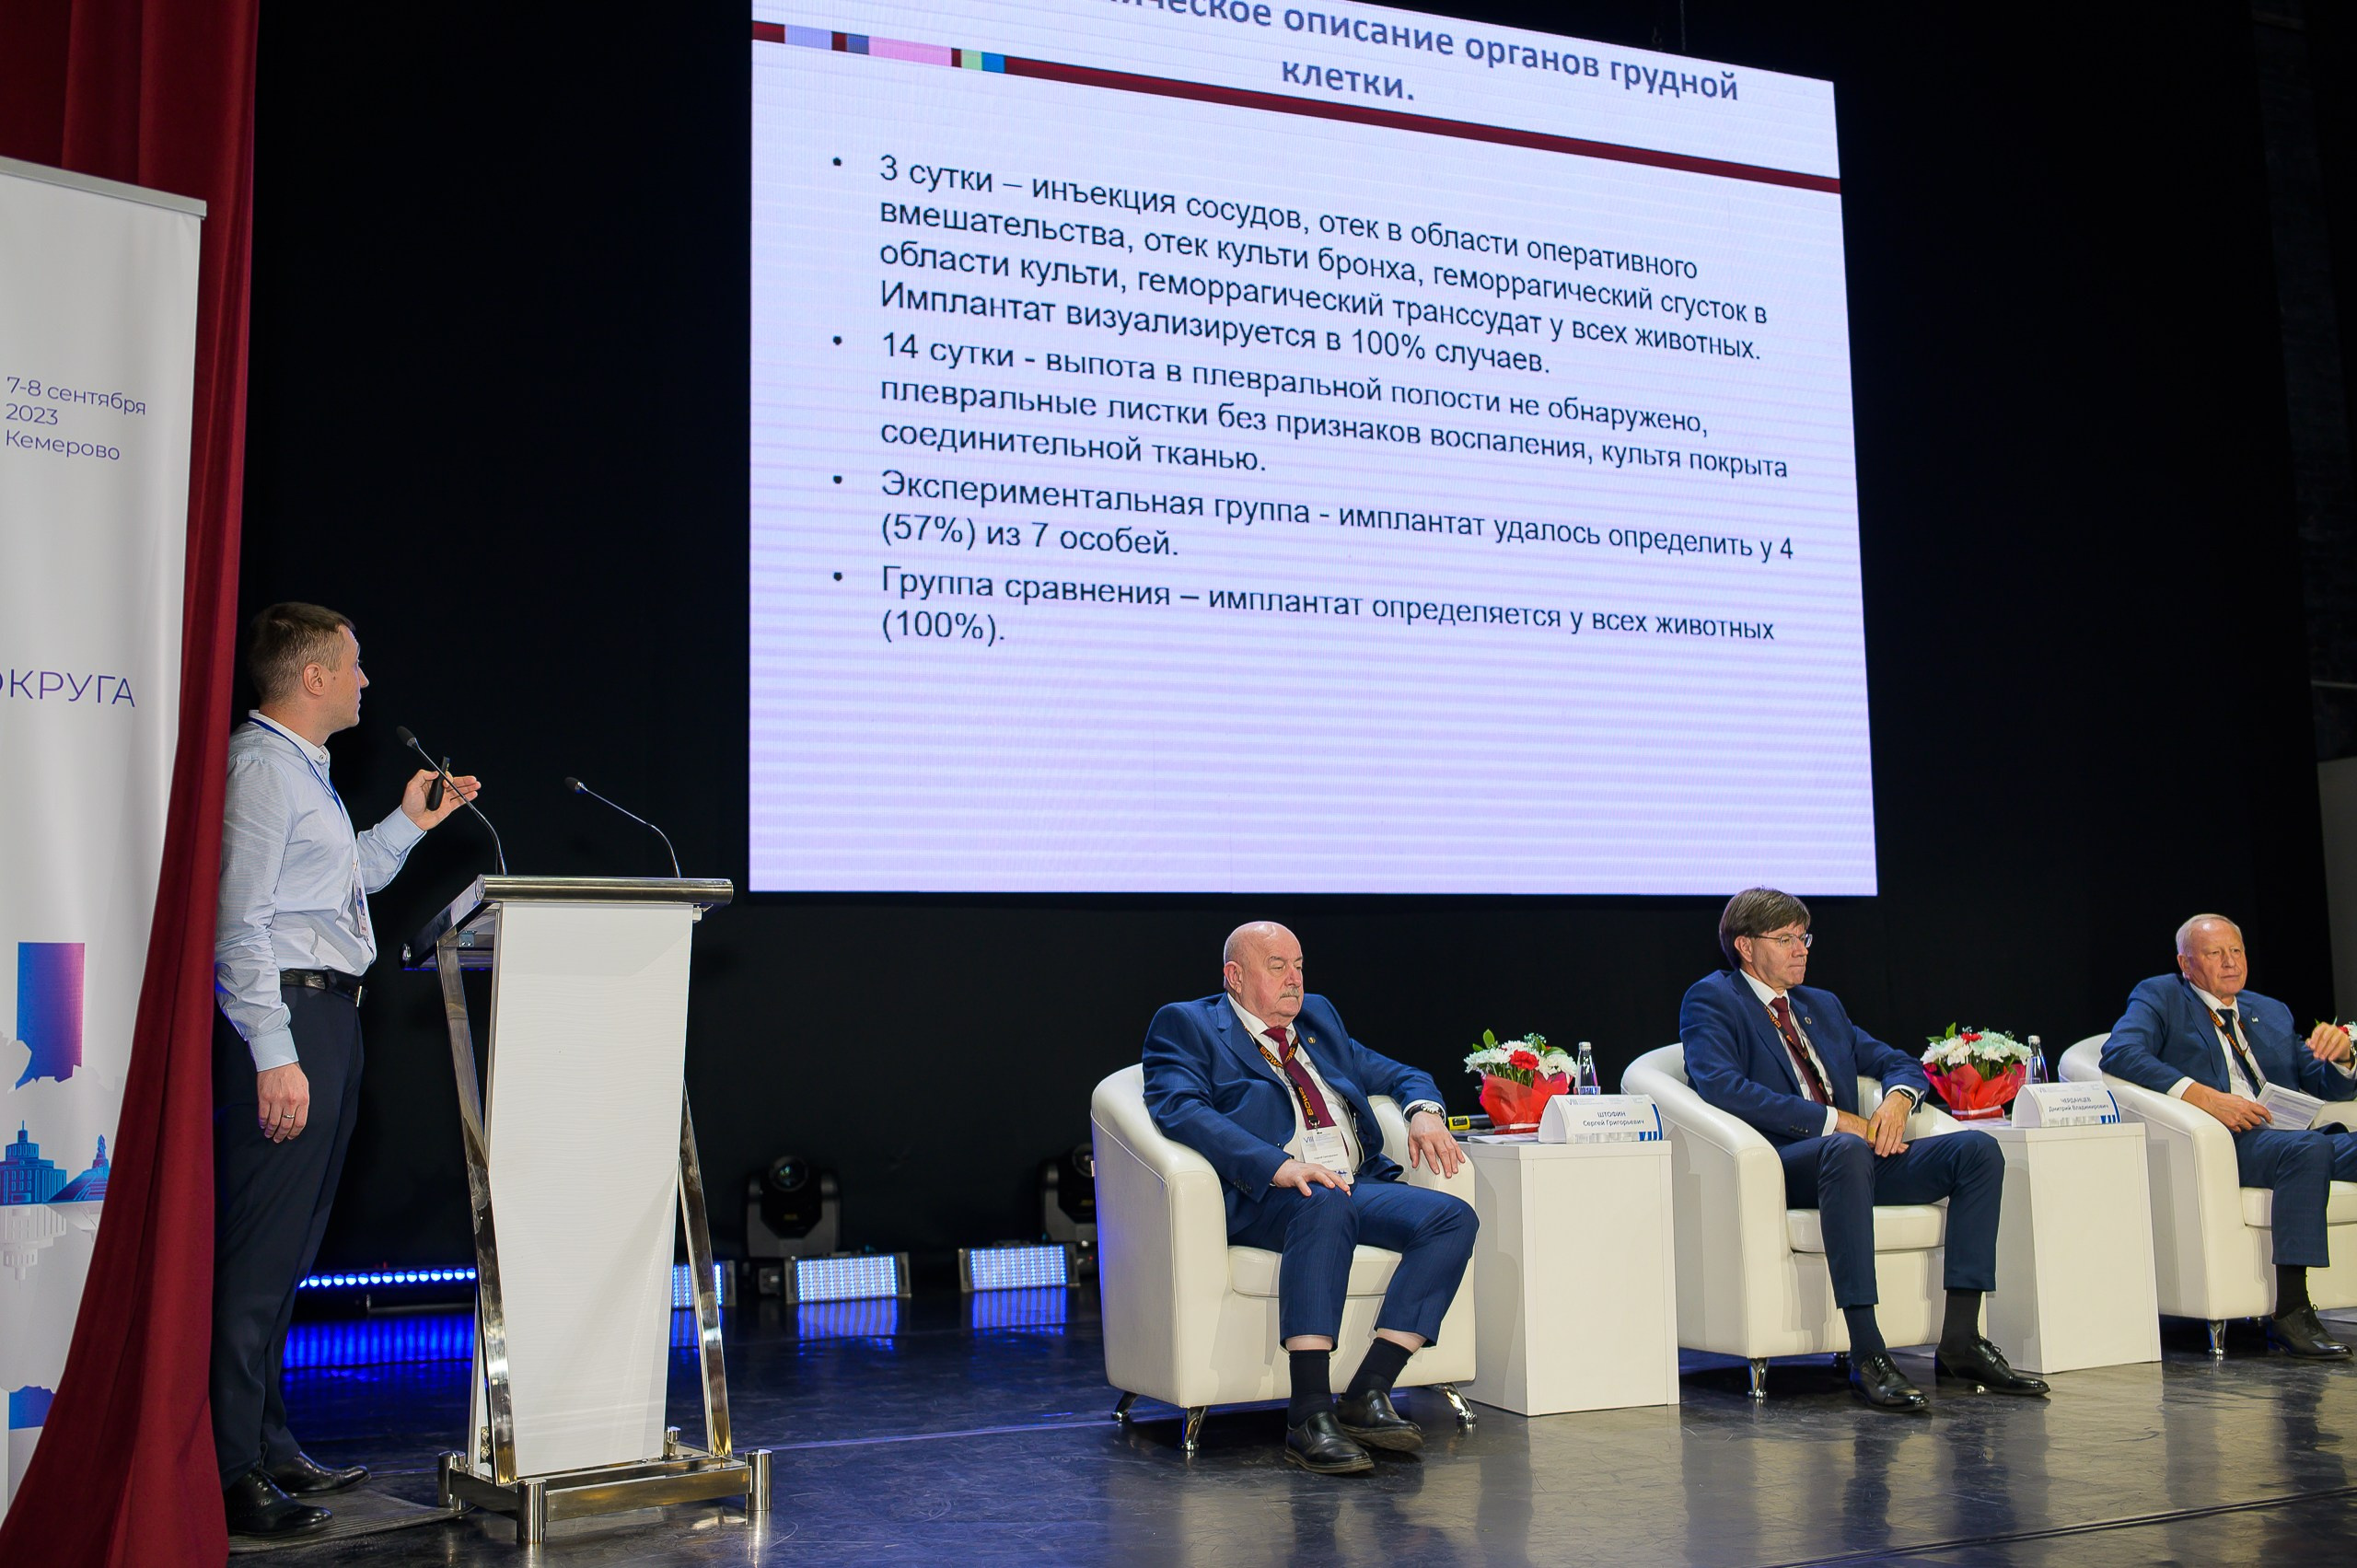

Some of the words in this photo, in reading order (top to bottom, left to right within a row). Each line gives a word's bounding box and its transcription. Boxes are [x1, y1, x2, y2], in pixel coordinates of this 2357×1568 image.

[1283, 8, 1454, 56] описание
[1465, 37, 1599, 77] органов
[1609, 61, 1737, 100] грудной
[1282, 61, 1415, 100] клетки.
[879, 154, 898, 181] 3
[909, 163, 993, 193] сутки
[1032, 178, 1176, 215] инъекция
[1186, 197, 1309, 235] сосудов,
[1318, 214, 1379, 239] отек
[1387, 222, 1403, 242] в
[1411, 221, 1518, 257] области
[1527, 239, 1698, 279] оперативного
[880, 202, 1133, 254] вмешательства,
[1144, 232, 1209, 258] отек
[1217, 239, 1308, 270] культи
[1318, 246, 1423, 287] бронха,
[1434, 266, 1653, 310] геморрагический
[1660, 294, 1748, 322] сгусток
[1754, 306, 1768, 324] в
[879, 239, 1009, 277] области
[1020, 258, 1126, 295] культи,
[1138, 271, 1383, 317] геморрагический
[1391, 299, 1542, 337] транссудат
[1550, 317, 1564, 343] у
[1572, 319, 1628, 344] всех
[1634, 327, 1760, 360] животных.
[881, 279, 1057, 322] Имплантат
[1066, 304, 1316, 349] визуализируется
[1326, 331, 1341, 352] в
[1352, 328, 1426, 360] 100%
[1435, 343, 1550, 374] случаев.
[6, 377, 41, 397] 7-8
[47, 384, 146, 415] сентября
[883, 331, 919, 359] 14
[929, 342, 1014, 370] сутки
[1046, 353, 1155, 380] выпота
[1167, 364, 1182, 382] в
[1192, 366, 1382, 401] плевральной
[1391, 386, 1501, 412] полости
[1509, 397, 1540, 416] не
[1548, 396, 1708, 438] обнаружено,
[6, 403, 58, 425] 2023
[881, 380, 1097, 416] плевральные
[1106, 399, 1208, 425] листки
[1217, 401, 1267, 431] без
[1276, 413, 1422, 444] признаков
[1430, 428, 1593, 465] воспаления,
[1601, 444, 1681, 469] культя
[1689, 452, 1788, 479] покрыта
[6, 429, 120, 460] Кемерово
[881, 424, 1142, 462] соединительной
[1151, 444, 1266, 471] тканью.
[881, 513, 976, 552] (57%)
[987, 525, 1021, 546] из
[1030, 521, 1049, 548] 7
[1060, 526, 1178, 556] особей.
[882, 469, 1203, 517] Экспериментальная
[1214, 498, 1310, 526] группа
[1339, 507, 1486, 537] имплантат
[1493, 519, 1601, 545] удалось
[1608, 528, 1753, 557] определить
[1759, 540, 1773, 564] у
[1780, 537, 1794, 560] 4
[883, 564, 993, 601] Группа
[1004, 578, 1170, 606] сравнения
[1209, 588, 1364, 616] имплантат
[1372, 598, 1561, 628] определяется
[1570, 610, 1584, 635] у
[1592, 612, 1648, 633] всех
[1655, 615, 1774, 640] животных
[882, 609, 1004, 647] (100%).
[0, 668, 135, 708] КРУГА
[1583, 1120, 1605, 1128] Сергей
[1606, 1119, 1644, 1127] Григорьевич
[1596, 1110, 1627, 1119] ШТОФИН
